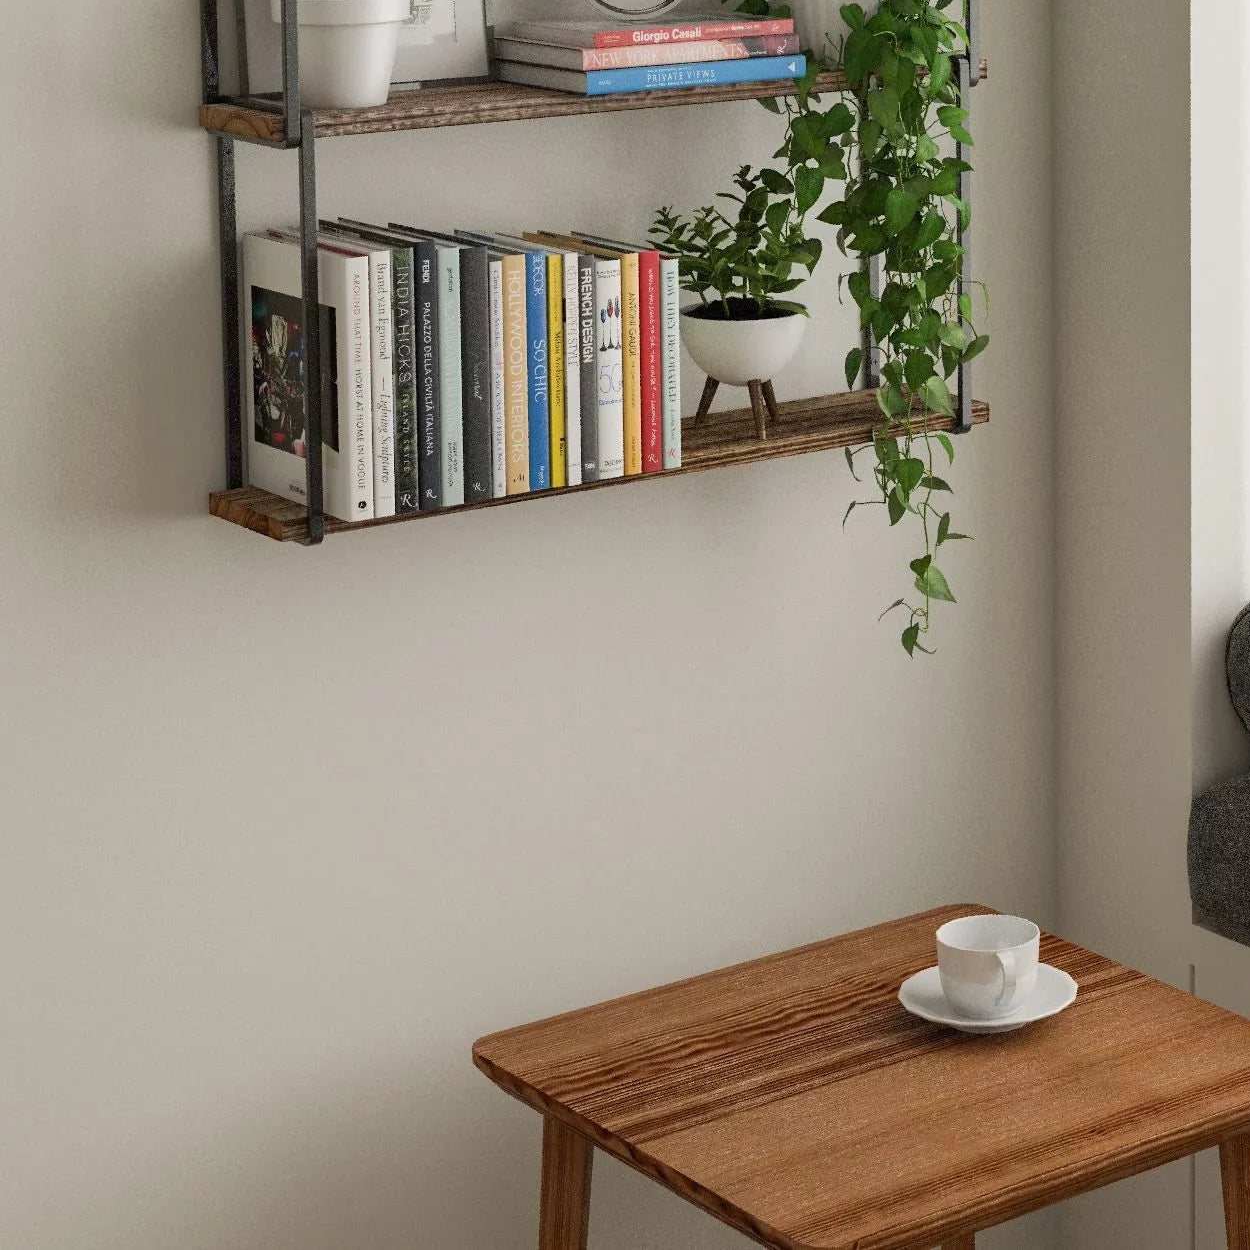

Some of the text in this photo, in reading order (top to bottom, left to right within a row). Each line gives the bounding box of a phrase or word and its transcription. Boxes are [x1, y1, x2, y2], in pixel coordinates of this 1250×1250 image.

[632, 30, 670, 43] Giorgio
[672, 26, 702, 40] Casali
[592, 52, 623, 67] NEW
[626, 50, 658, 65] YORK
[665, 43, 746, 62] APARTMENTS
[647, 71, 683, 83] PRIVATE
[687, 69, 715, 79] VIEWS
[377, 263, 388, 293] Brand
[422, 260, 430, 283] FENDI
[567, 265, 577, 294] KELLY
[666, 271, 676, 296] HOW
[378, 297, 386, 315] van
[581, 267, 595, 363] FRENCH DESIGN
[628, 292, 636, 326] ANTONI
[666, 301, 676, 331] THEY
[396, 267, 412, 384] INDIA HICKS
[422, 302, 432, 343] PALAZZO
[376, 318, 390, 360] Egmond
[568, 338, 579, 367] STYLE
[424, 346, 433, 375] DELLA
[507, 270, 525, 463] HOLLYWOOD INTERIORS
[533, 340, 547, 403] SO CHIC
[353, 274, 366, 489] AROUND THAT TIME HORST AT HOME IN VOGUE
[401, 393, 411, 472] ISLAND STYLE
[425, 414, 434, 456] ITALIANA
[378, 436, 392, 484] Sculptures
